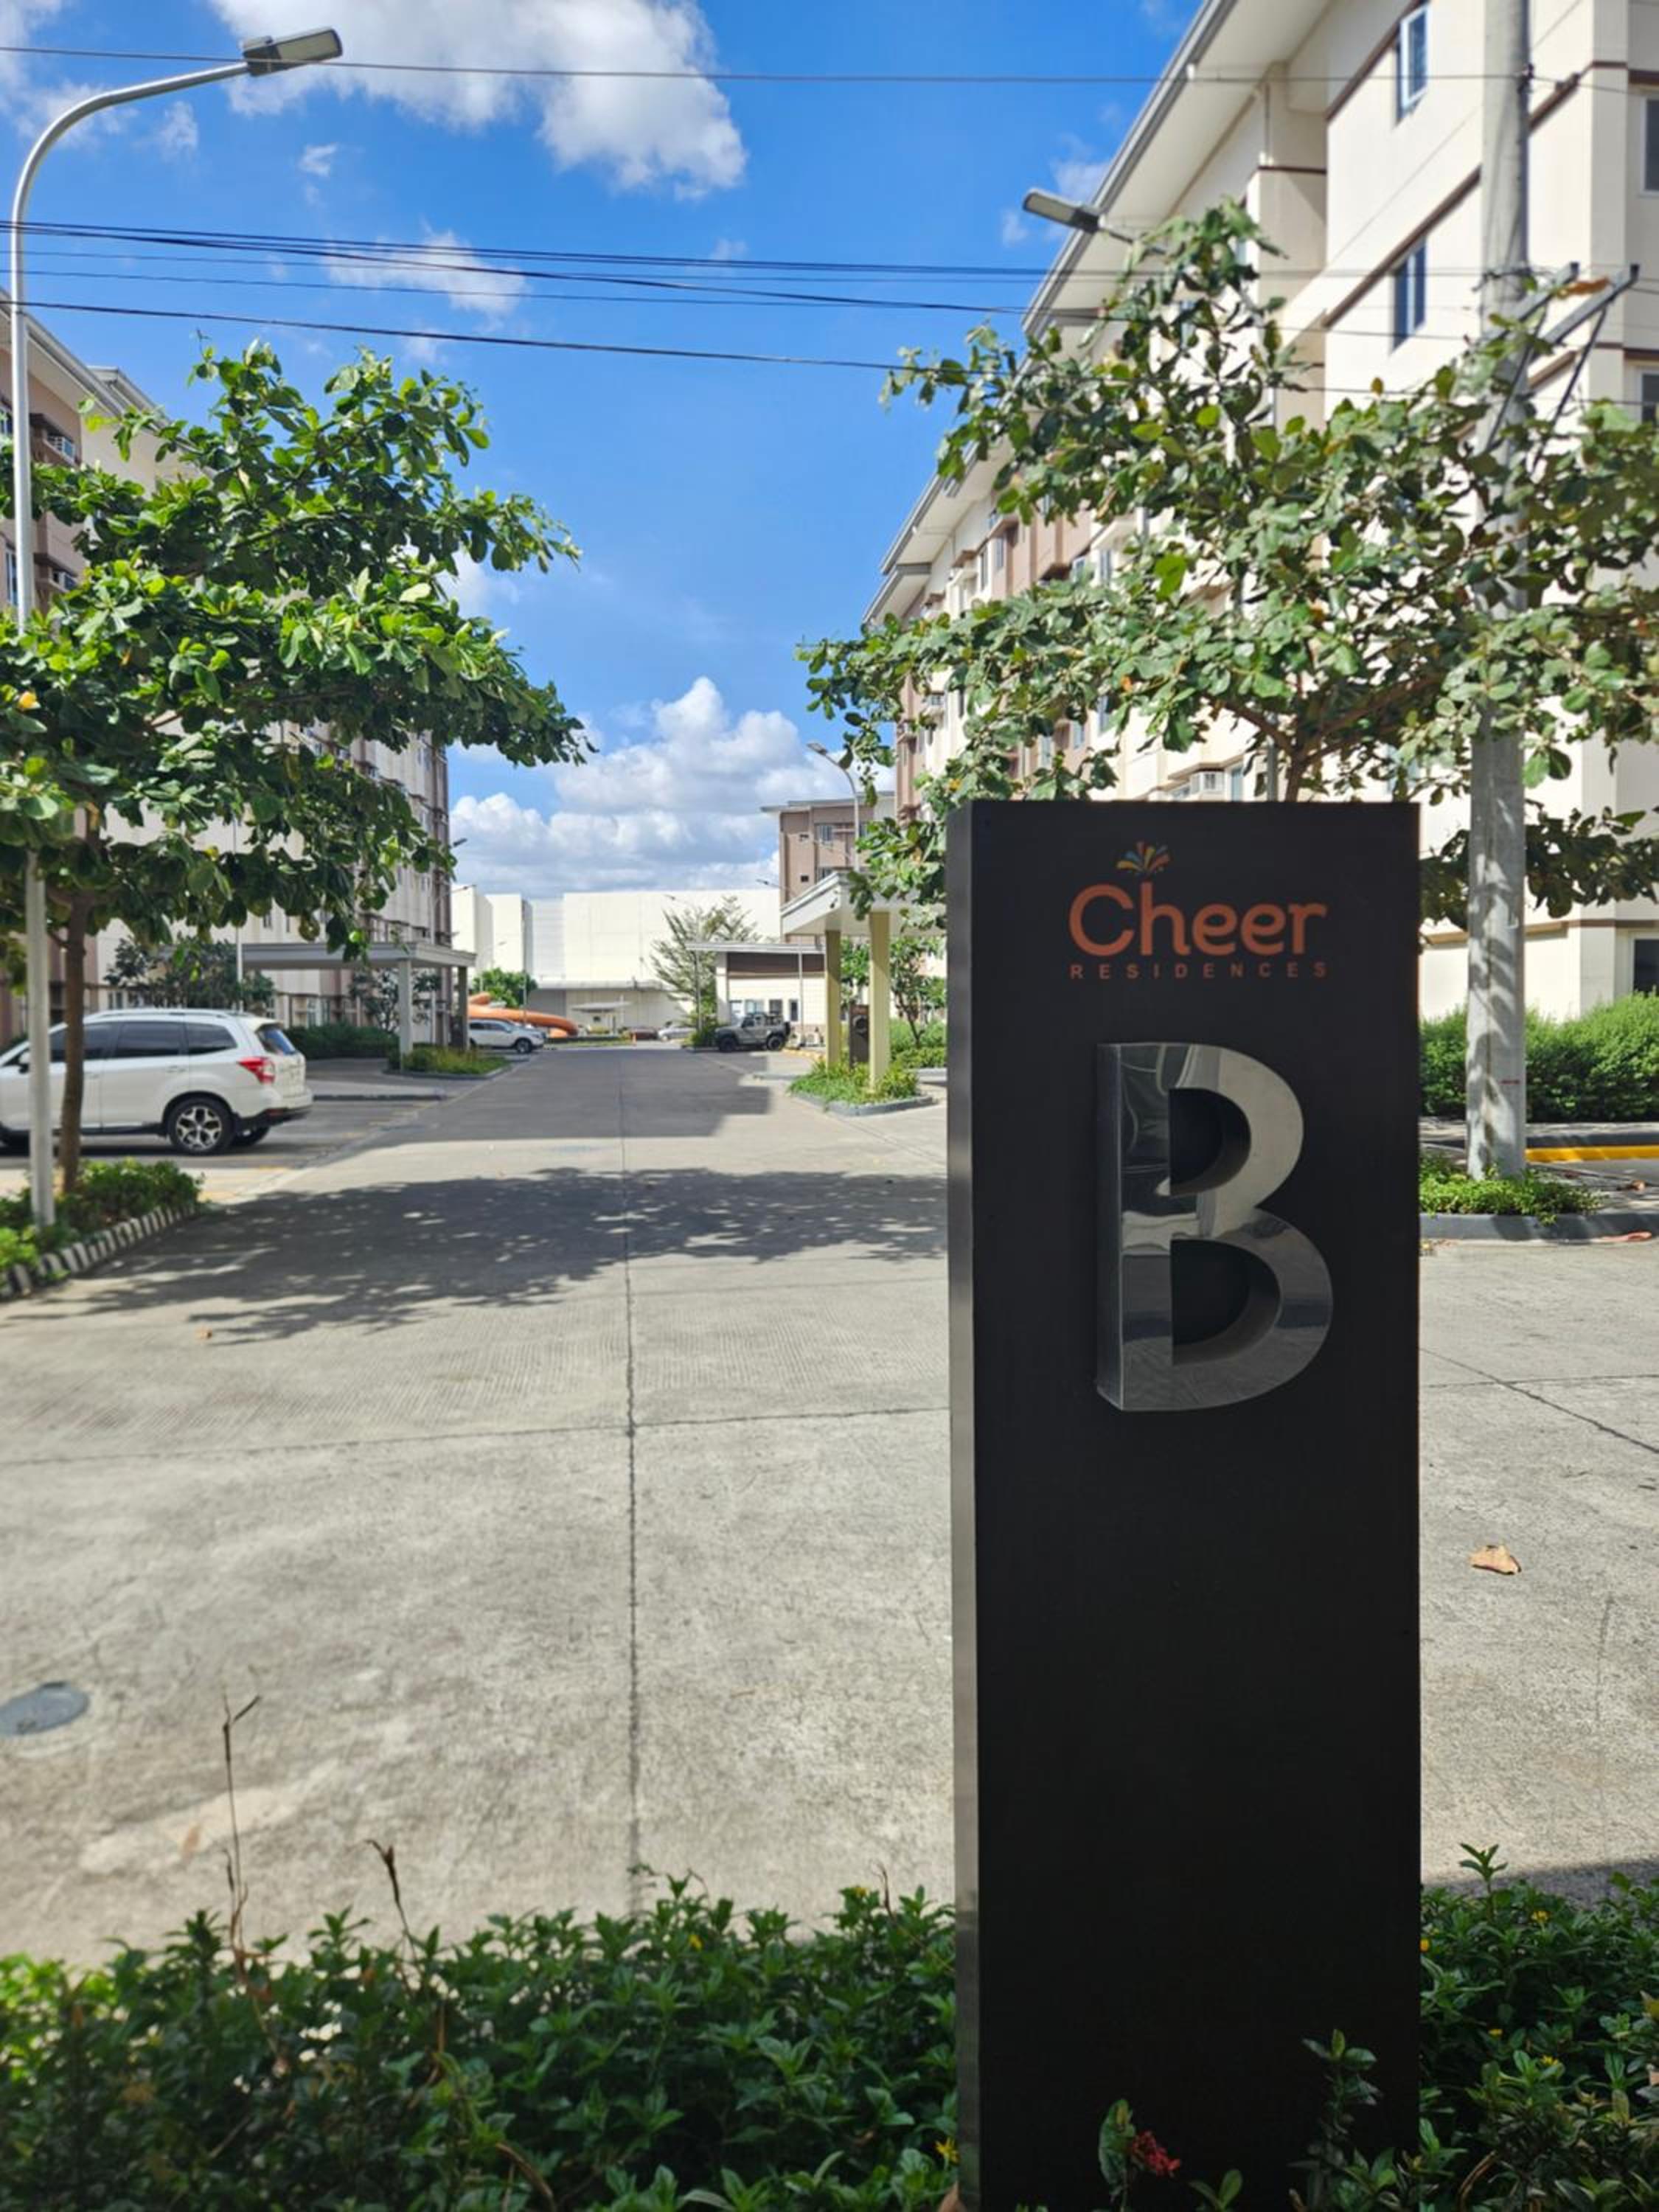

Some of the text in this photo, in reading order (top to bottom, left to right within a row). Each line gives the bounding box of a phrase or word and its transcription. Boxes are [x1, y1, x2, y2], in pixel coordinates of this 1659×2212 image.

[1069, 882, 1326, 956] Cheer
[1070, 961, 1327, 979] RESIDENCES
[1097, 1041, 1334, 1411] B
